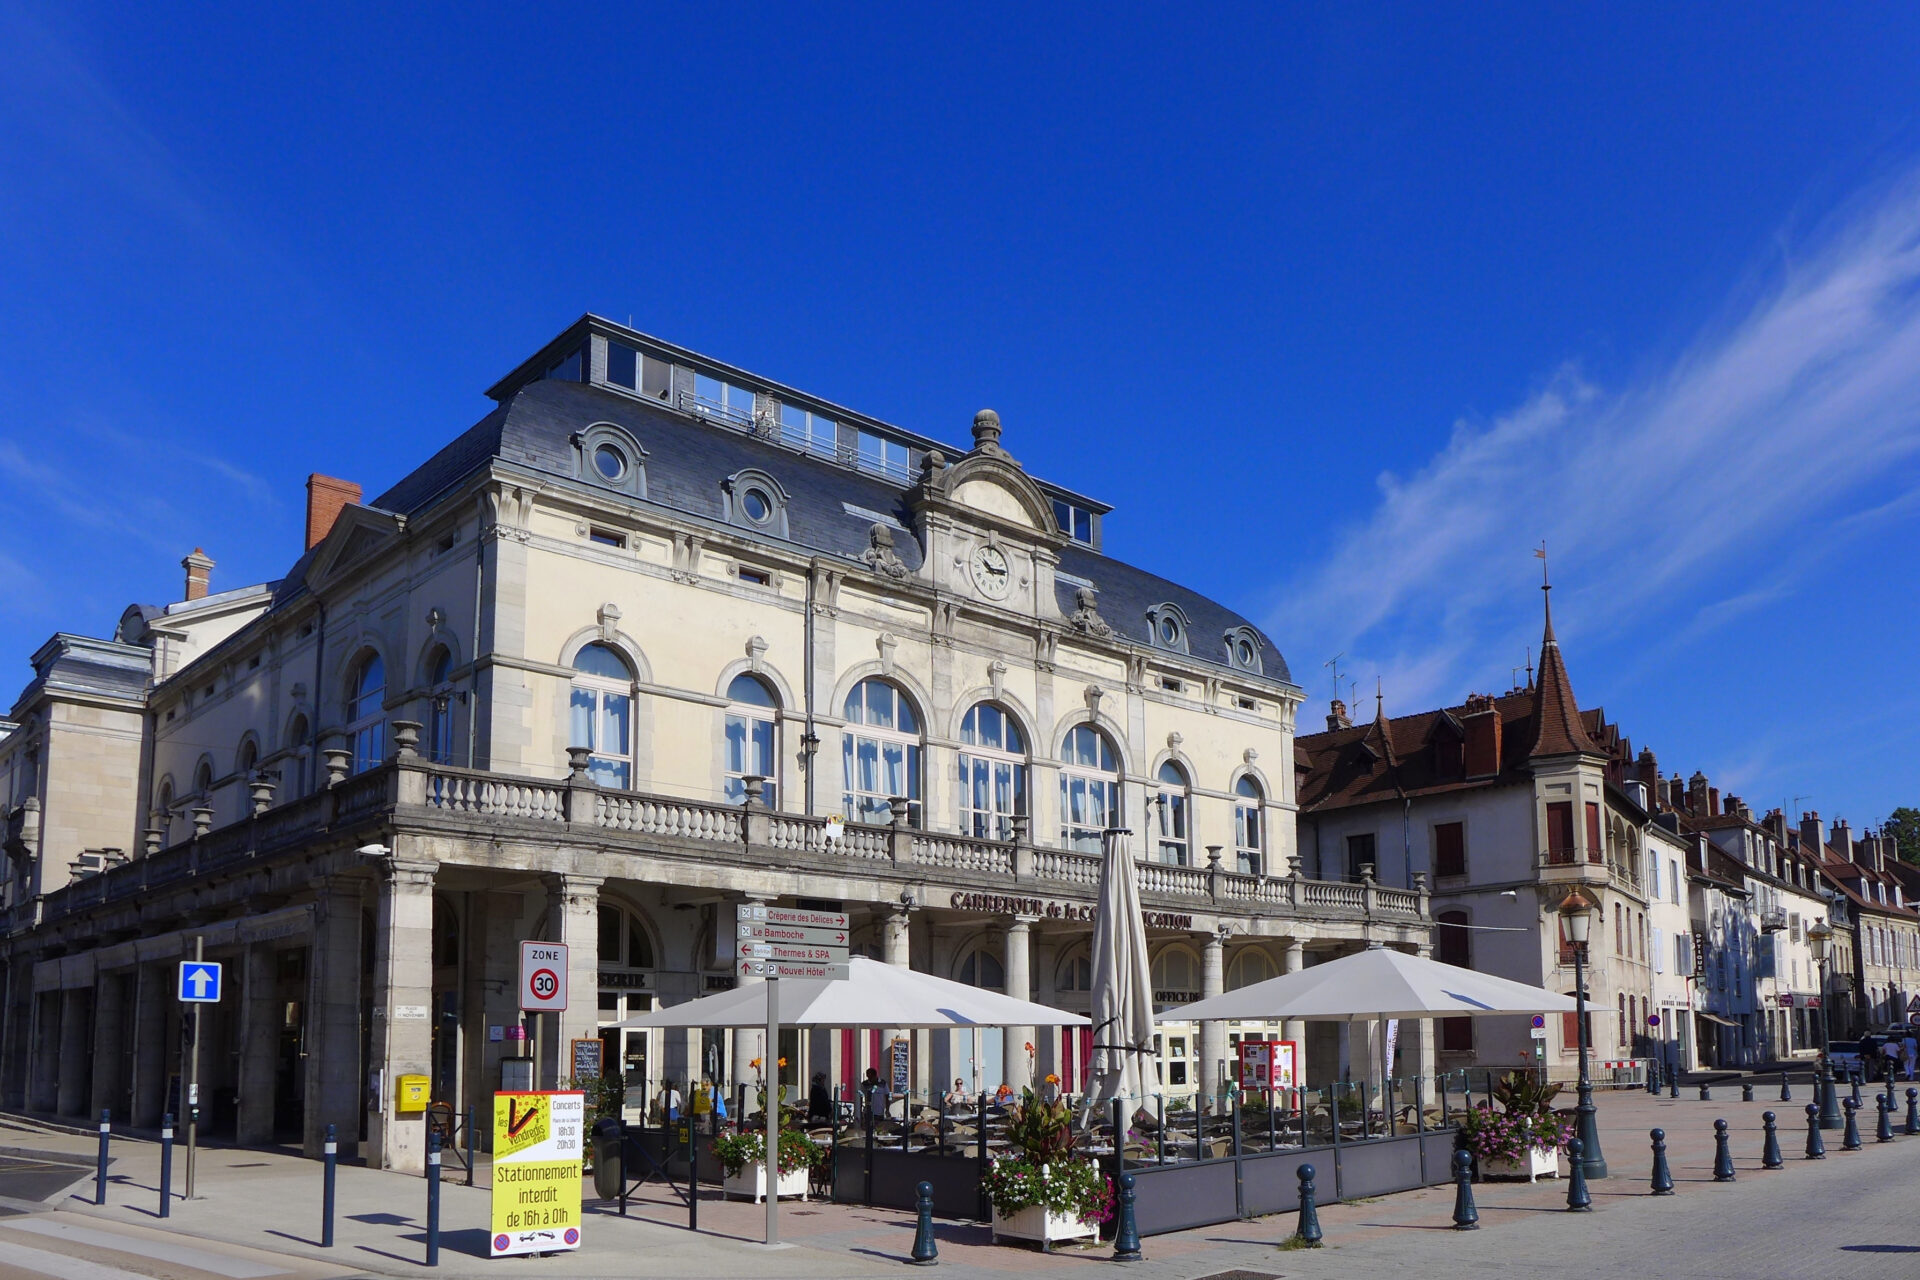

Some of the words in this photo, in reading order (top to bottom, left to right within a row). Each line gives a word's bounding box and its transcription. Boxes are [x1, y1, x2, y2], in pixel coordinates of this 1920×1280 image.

[950, 891, 1043, 916] CARREFOUR
[1046, 901, 1062, 918] de
[768, 911, 797, 923] Crêperie
[797, 913, 809, 923] des
[753, 928, 762, 936] Le
[764, 928, 805, 940] Bamboche
[532, 950, 559, 961] ZONE
[773, 947, 806, 957] Thermes
[807, 949, 813, 958] &
[815, 949, 830, 959] SPA
[778, 966, 805, 976] Nouvel
[806, 966, 826, 976] Hôtel
[536, 977, 554, 992] 30
[1155, 991, 1188, 1003] OFFICE
[552, 1100, 581, 1110] Concerts
[558, 1126, 575, 1136] 18h30
[557, 1139, 576, 1150] 20h30
[498, 1163, 578, 1183] Stationnement
[518, 1186, 557, 1204] interdit
[506, 1211, 520, 1228] de
[523, 1210, 540, 1226] 16h
[542, 1208, 549, 1225] à
[552, 1207, 568, 1224] 01h
